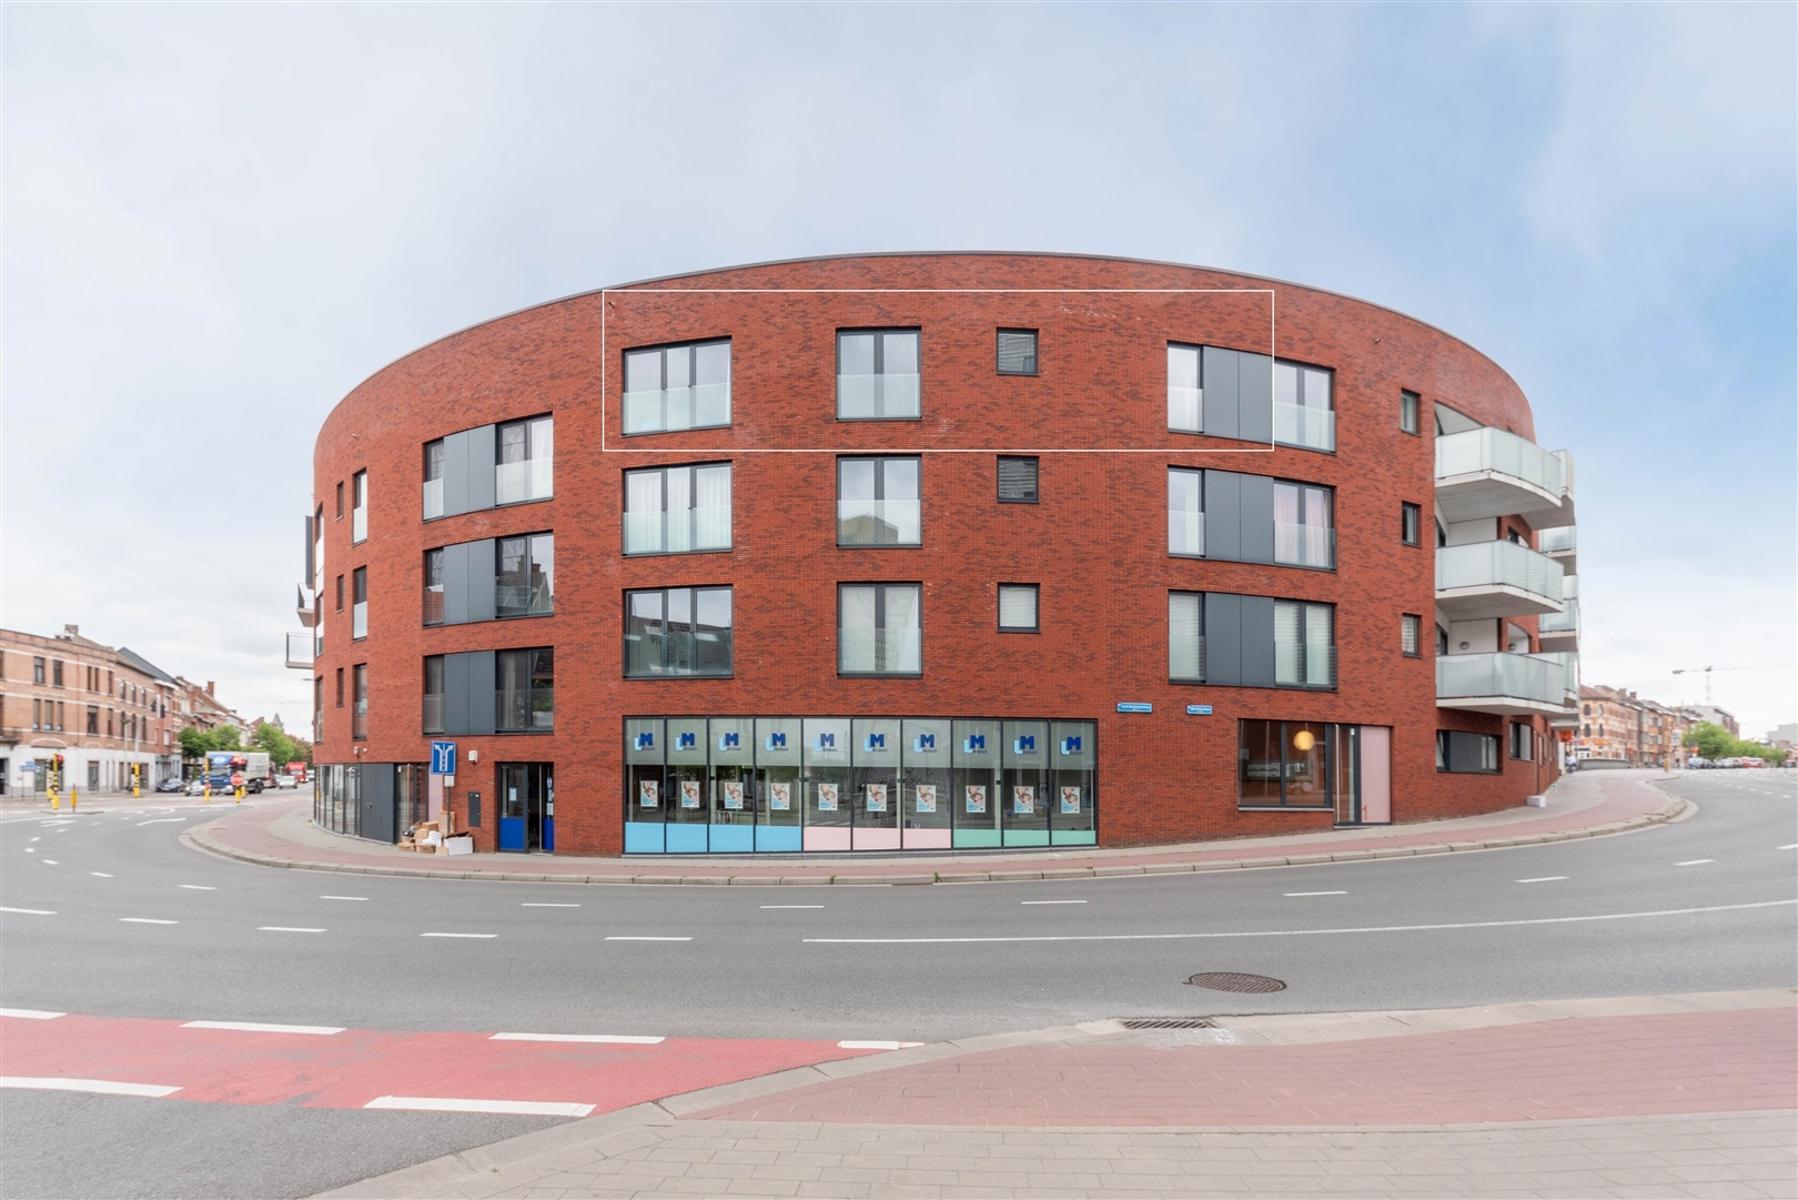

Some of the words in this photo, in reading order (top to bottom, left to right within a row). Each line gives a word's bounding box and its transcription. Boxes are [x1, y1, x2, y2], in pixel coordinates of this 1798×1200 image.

[640, 732, 653, 746] M
[682, 733, 695, 746] M
[725, 733, 739, 746] M
[772, 733, 786, 746] M
[820, 733, 834, 747] M
[870, 734, 884, 747] M
[920, 734, 934, 748] M
[970, 734, 984, 748] M
[1020, 736, 1034, 749] M
[1067, 736, 1081, 750] M
